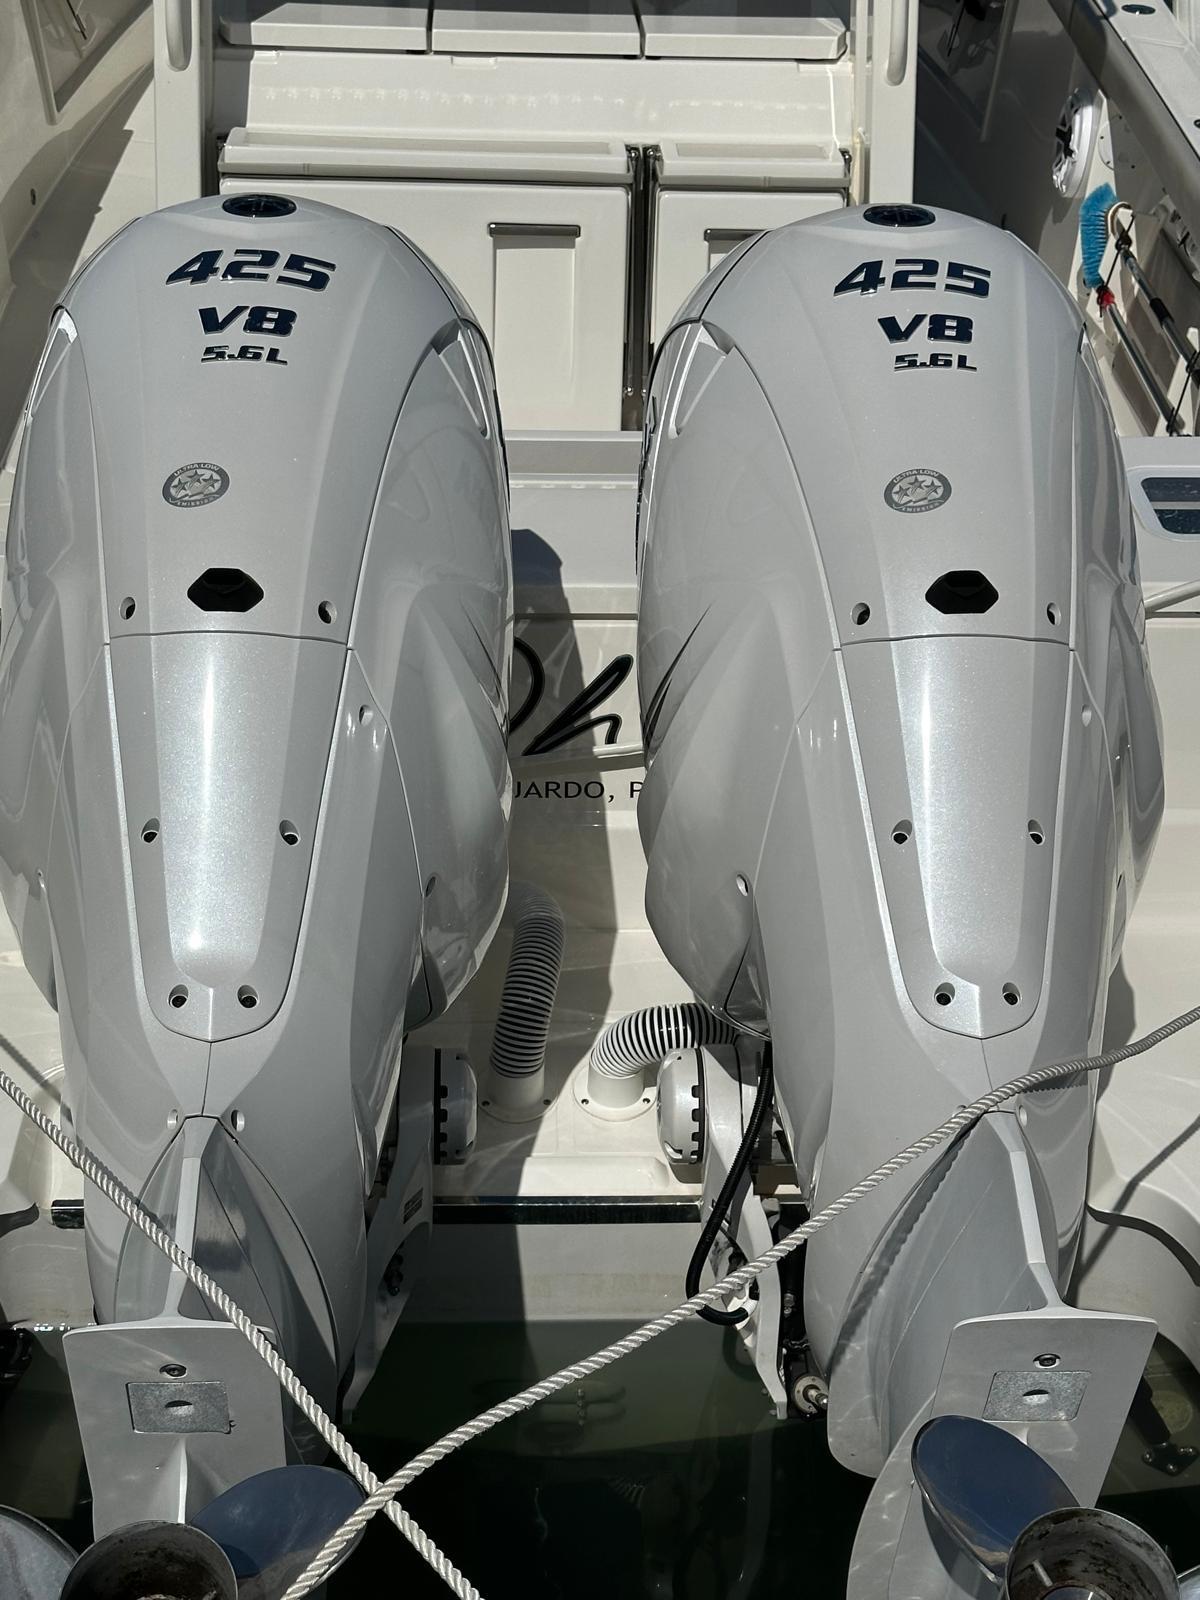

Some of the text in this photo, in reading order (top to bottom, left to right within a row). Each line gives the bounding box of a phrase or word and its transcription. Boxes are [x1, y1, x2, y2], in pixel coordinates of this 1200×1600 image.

[166, 249, 336, 292] 425
[833, 258, 991, 298] 425
[199, 305, 297, 337] V8
[877, 314, 973, 344] V8
[201, 345, 288, 365] 5.6L
[894, 353, 977, 372] 5.6L
[514, 781, 614, 803] JARDO,
